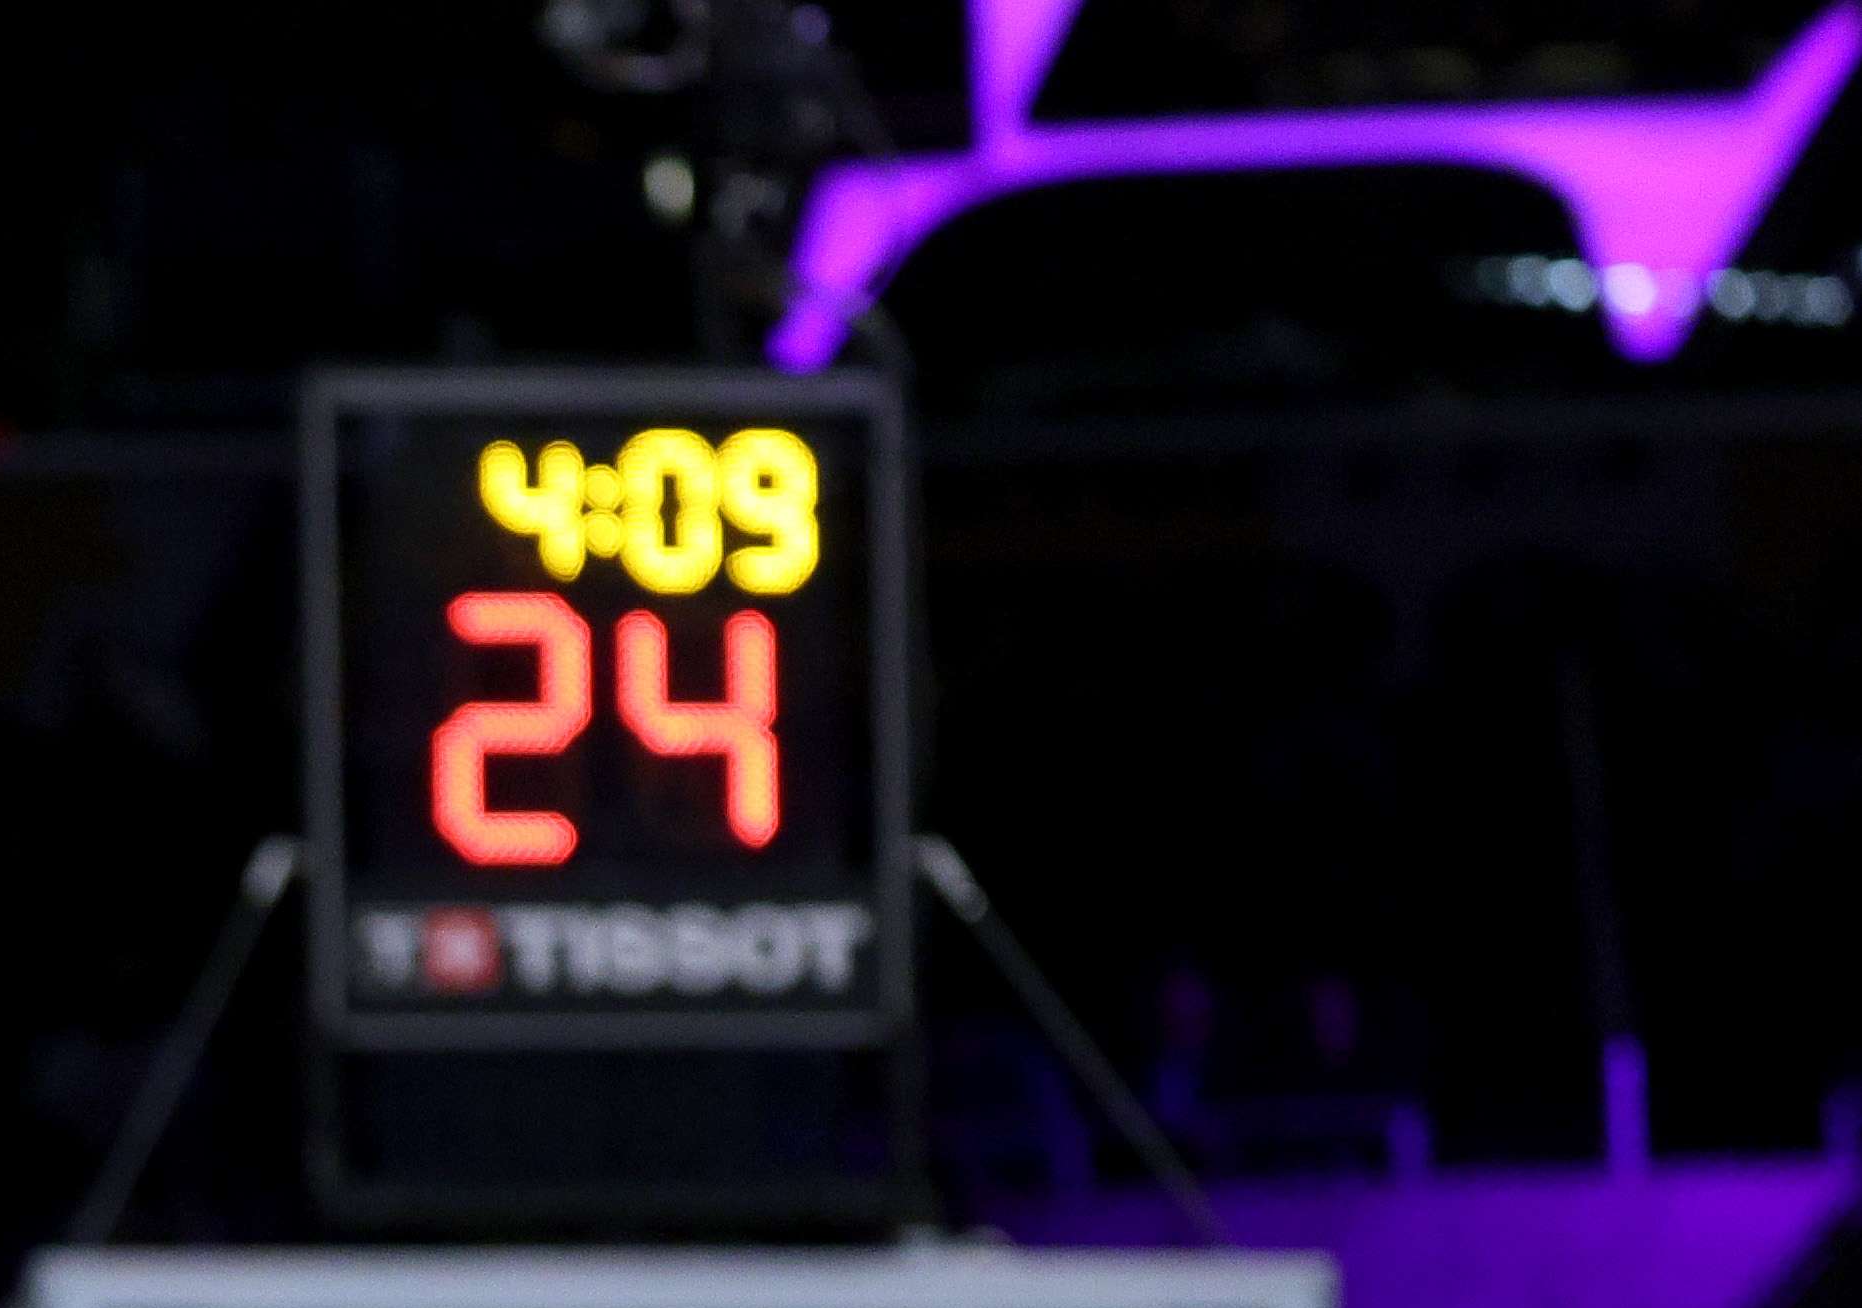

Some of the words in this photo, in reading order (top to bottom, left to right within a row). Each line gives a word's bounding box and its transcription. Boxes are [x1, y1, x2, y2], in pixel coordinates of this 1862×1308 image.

[478, 427, 820, 595] 4:09
[430, 590, 780, 867] 24
[498, 900, 868, 996] TISSOT
